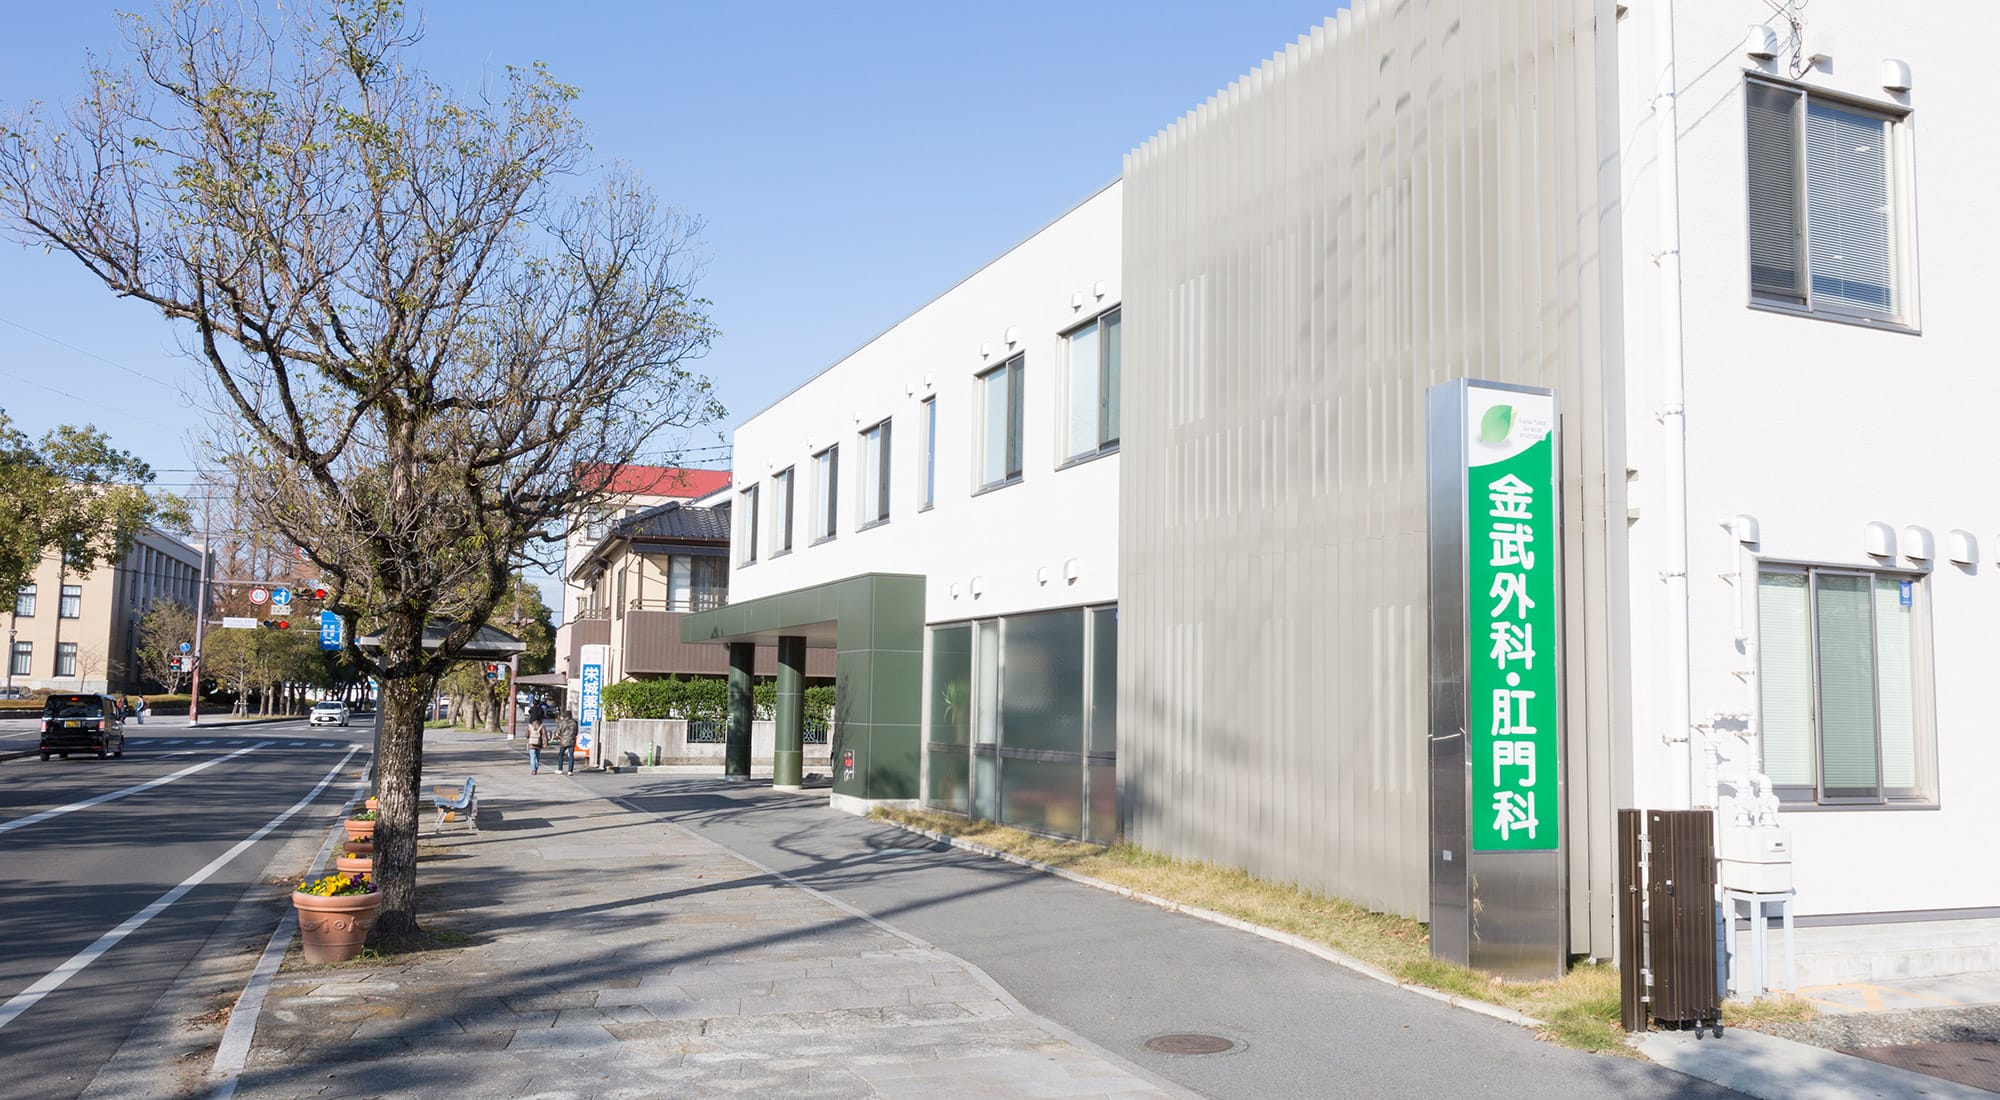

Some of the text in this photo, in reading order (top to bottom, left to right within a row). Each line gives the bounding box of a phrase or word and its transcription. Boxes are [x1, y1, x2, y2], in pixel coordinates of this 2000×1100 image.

[583, 666, 599, 723] 栄城薬局
[1488, 473, 1539, 841] 金武外科・肛門科
